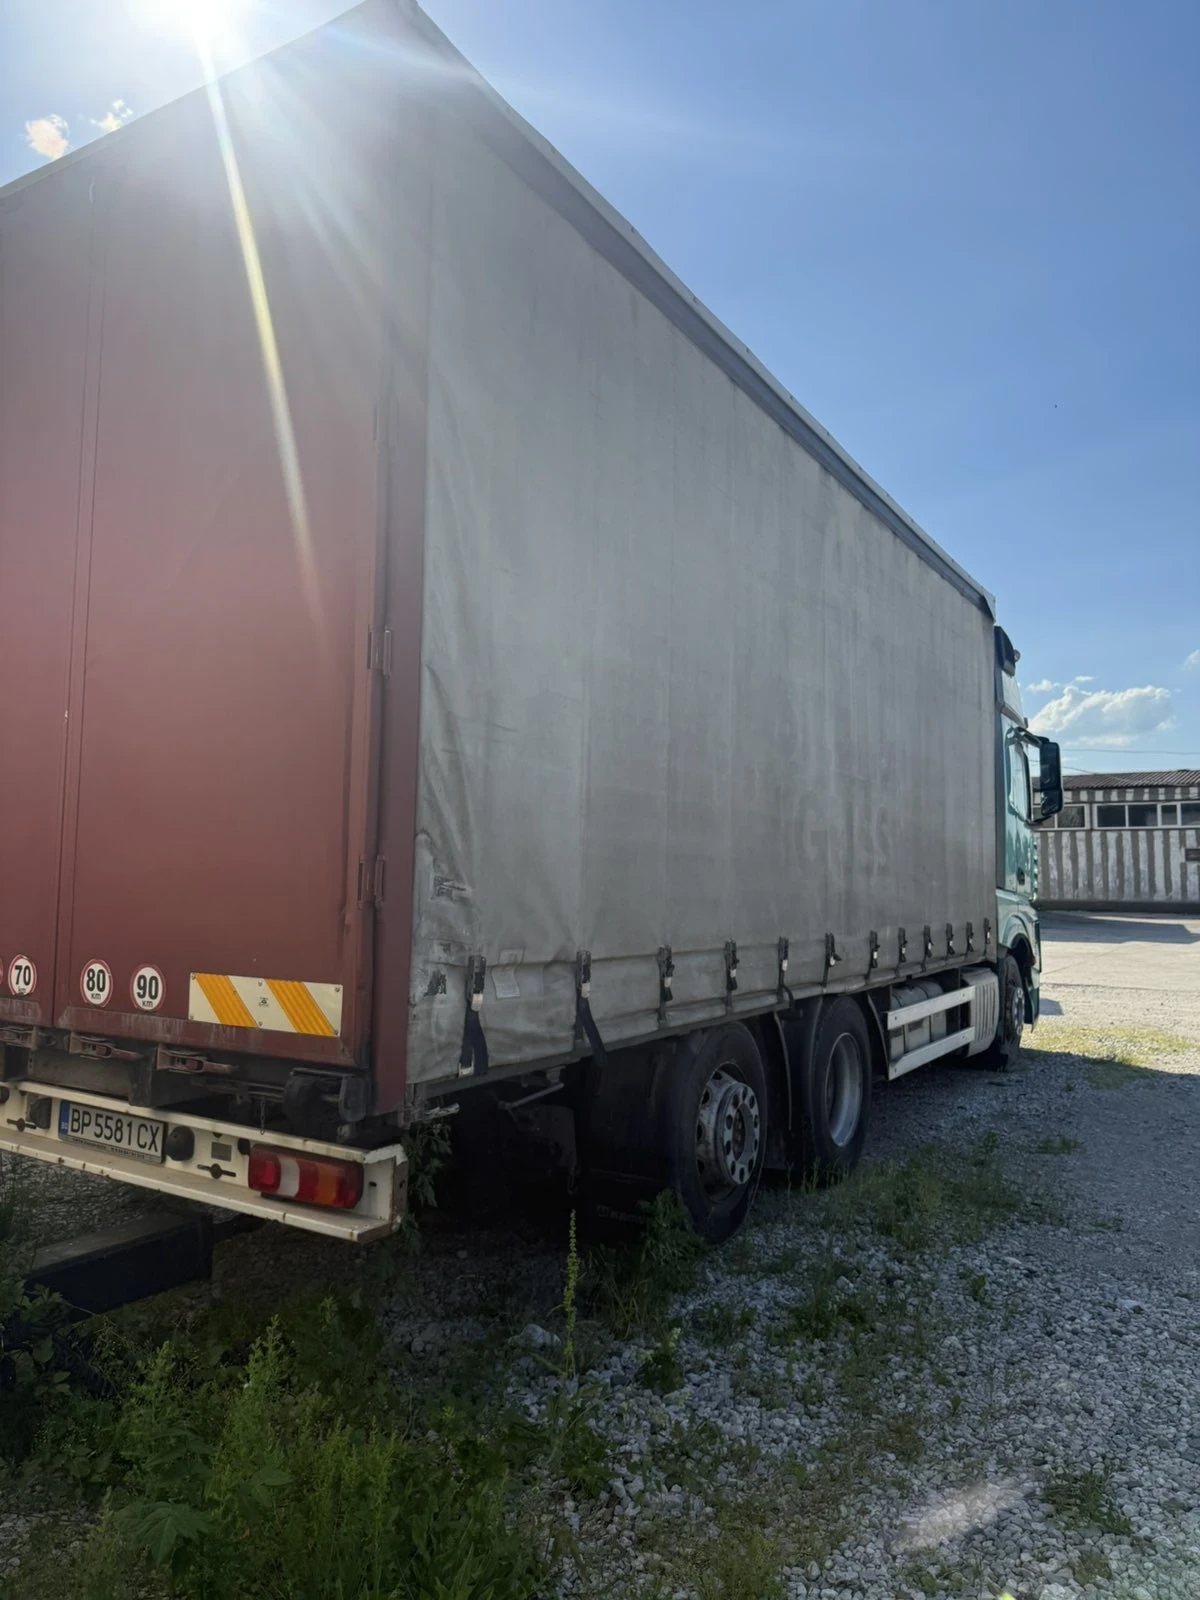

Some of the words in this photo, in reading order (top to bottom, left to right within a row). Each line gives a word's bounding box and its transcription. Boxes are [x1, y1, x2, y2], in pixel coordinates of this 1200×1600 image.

[14, 964, 31, 986] 70
[86, 968, 106, 992] 80
[136, 974, 159, 1000] 90
